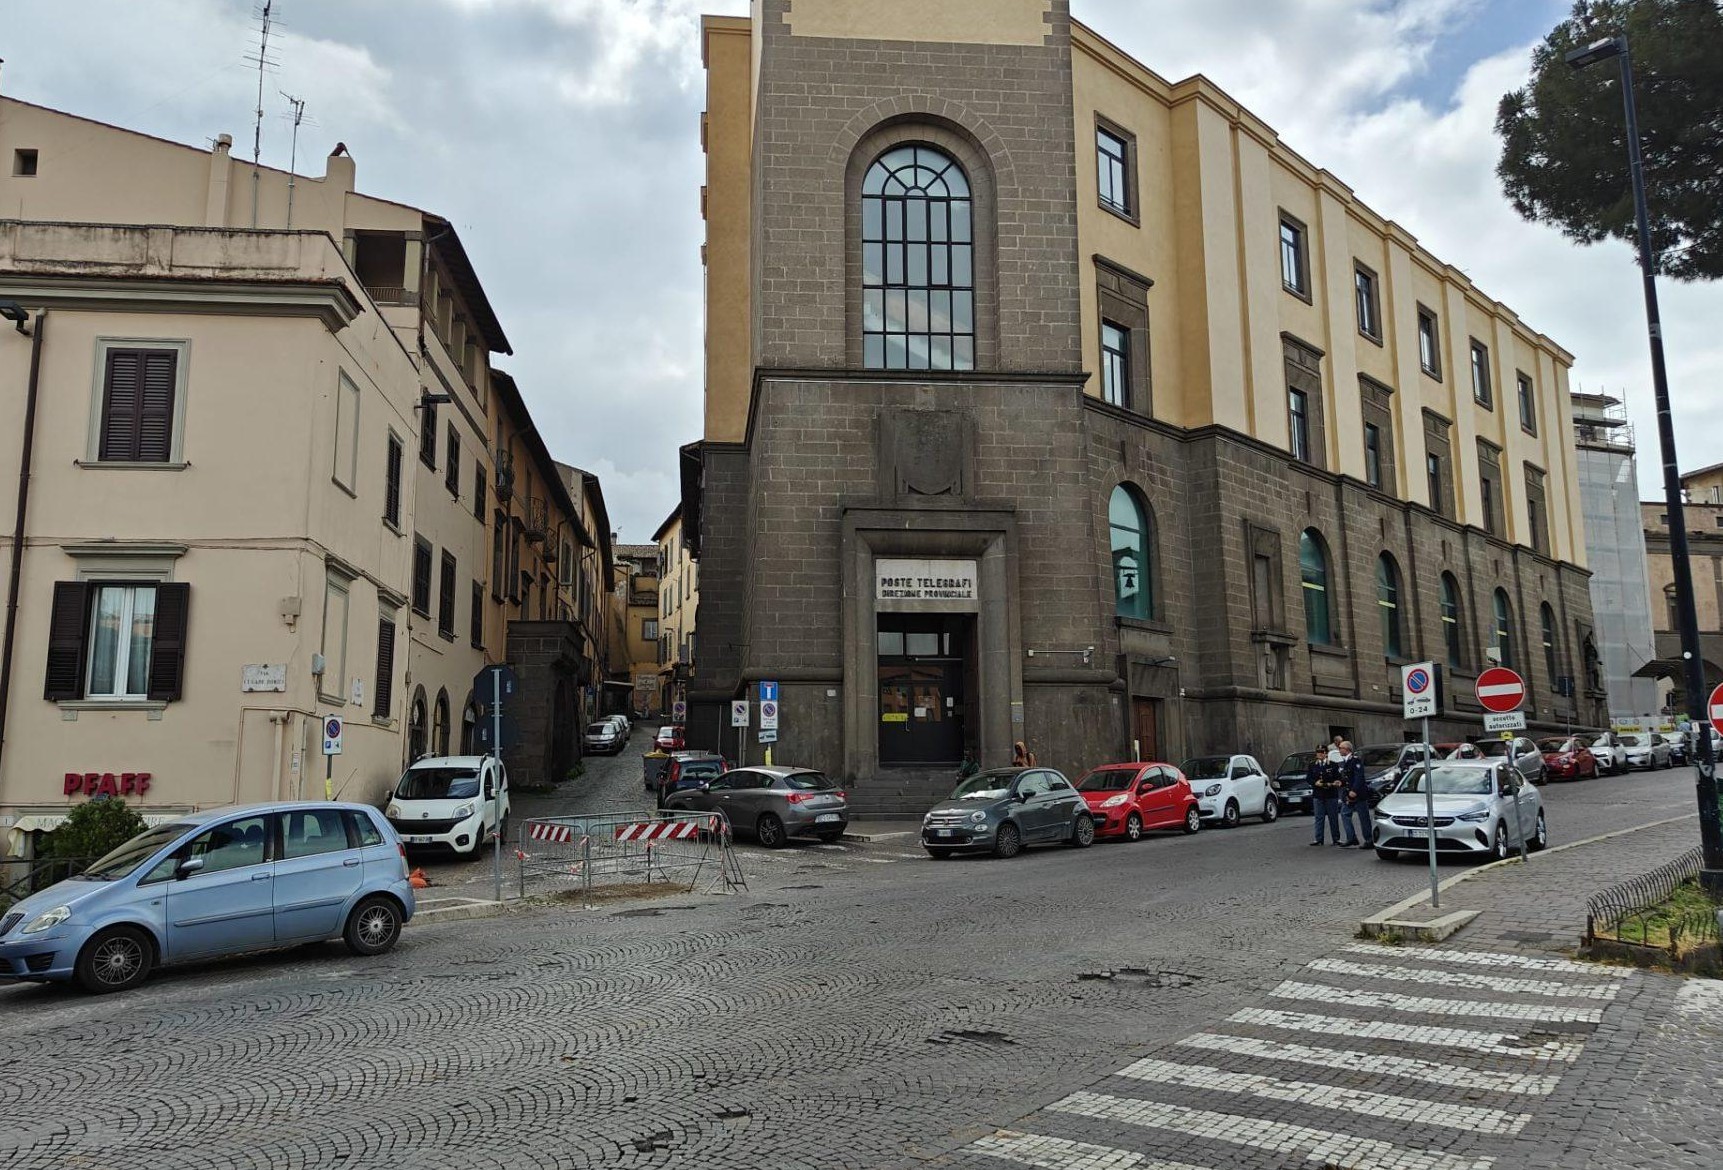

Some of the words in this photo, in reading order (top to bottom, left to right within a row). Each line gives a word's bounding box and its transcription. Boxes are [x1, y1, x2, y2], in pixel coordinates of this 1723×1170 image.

[881, 577, 912, 588] POSTE
[917, 577, 972, 588] TELEGRAFI
[882, 589, 921, 598] DIREZIONE
[924, 589, 972, 599] PROVINCIALE
[1409, 705, 1428, 714] 0-24
[1488, 721, 1522, 730] autorizzati
[63, 773, 152, 797] PFAFF
